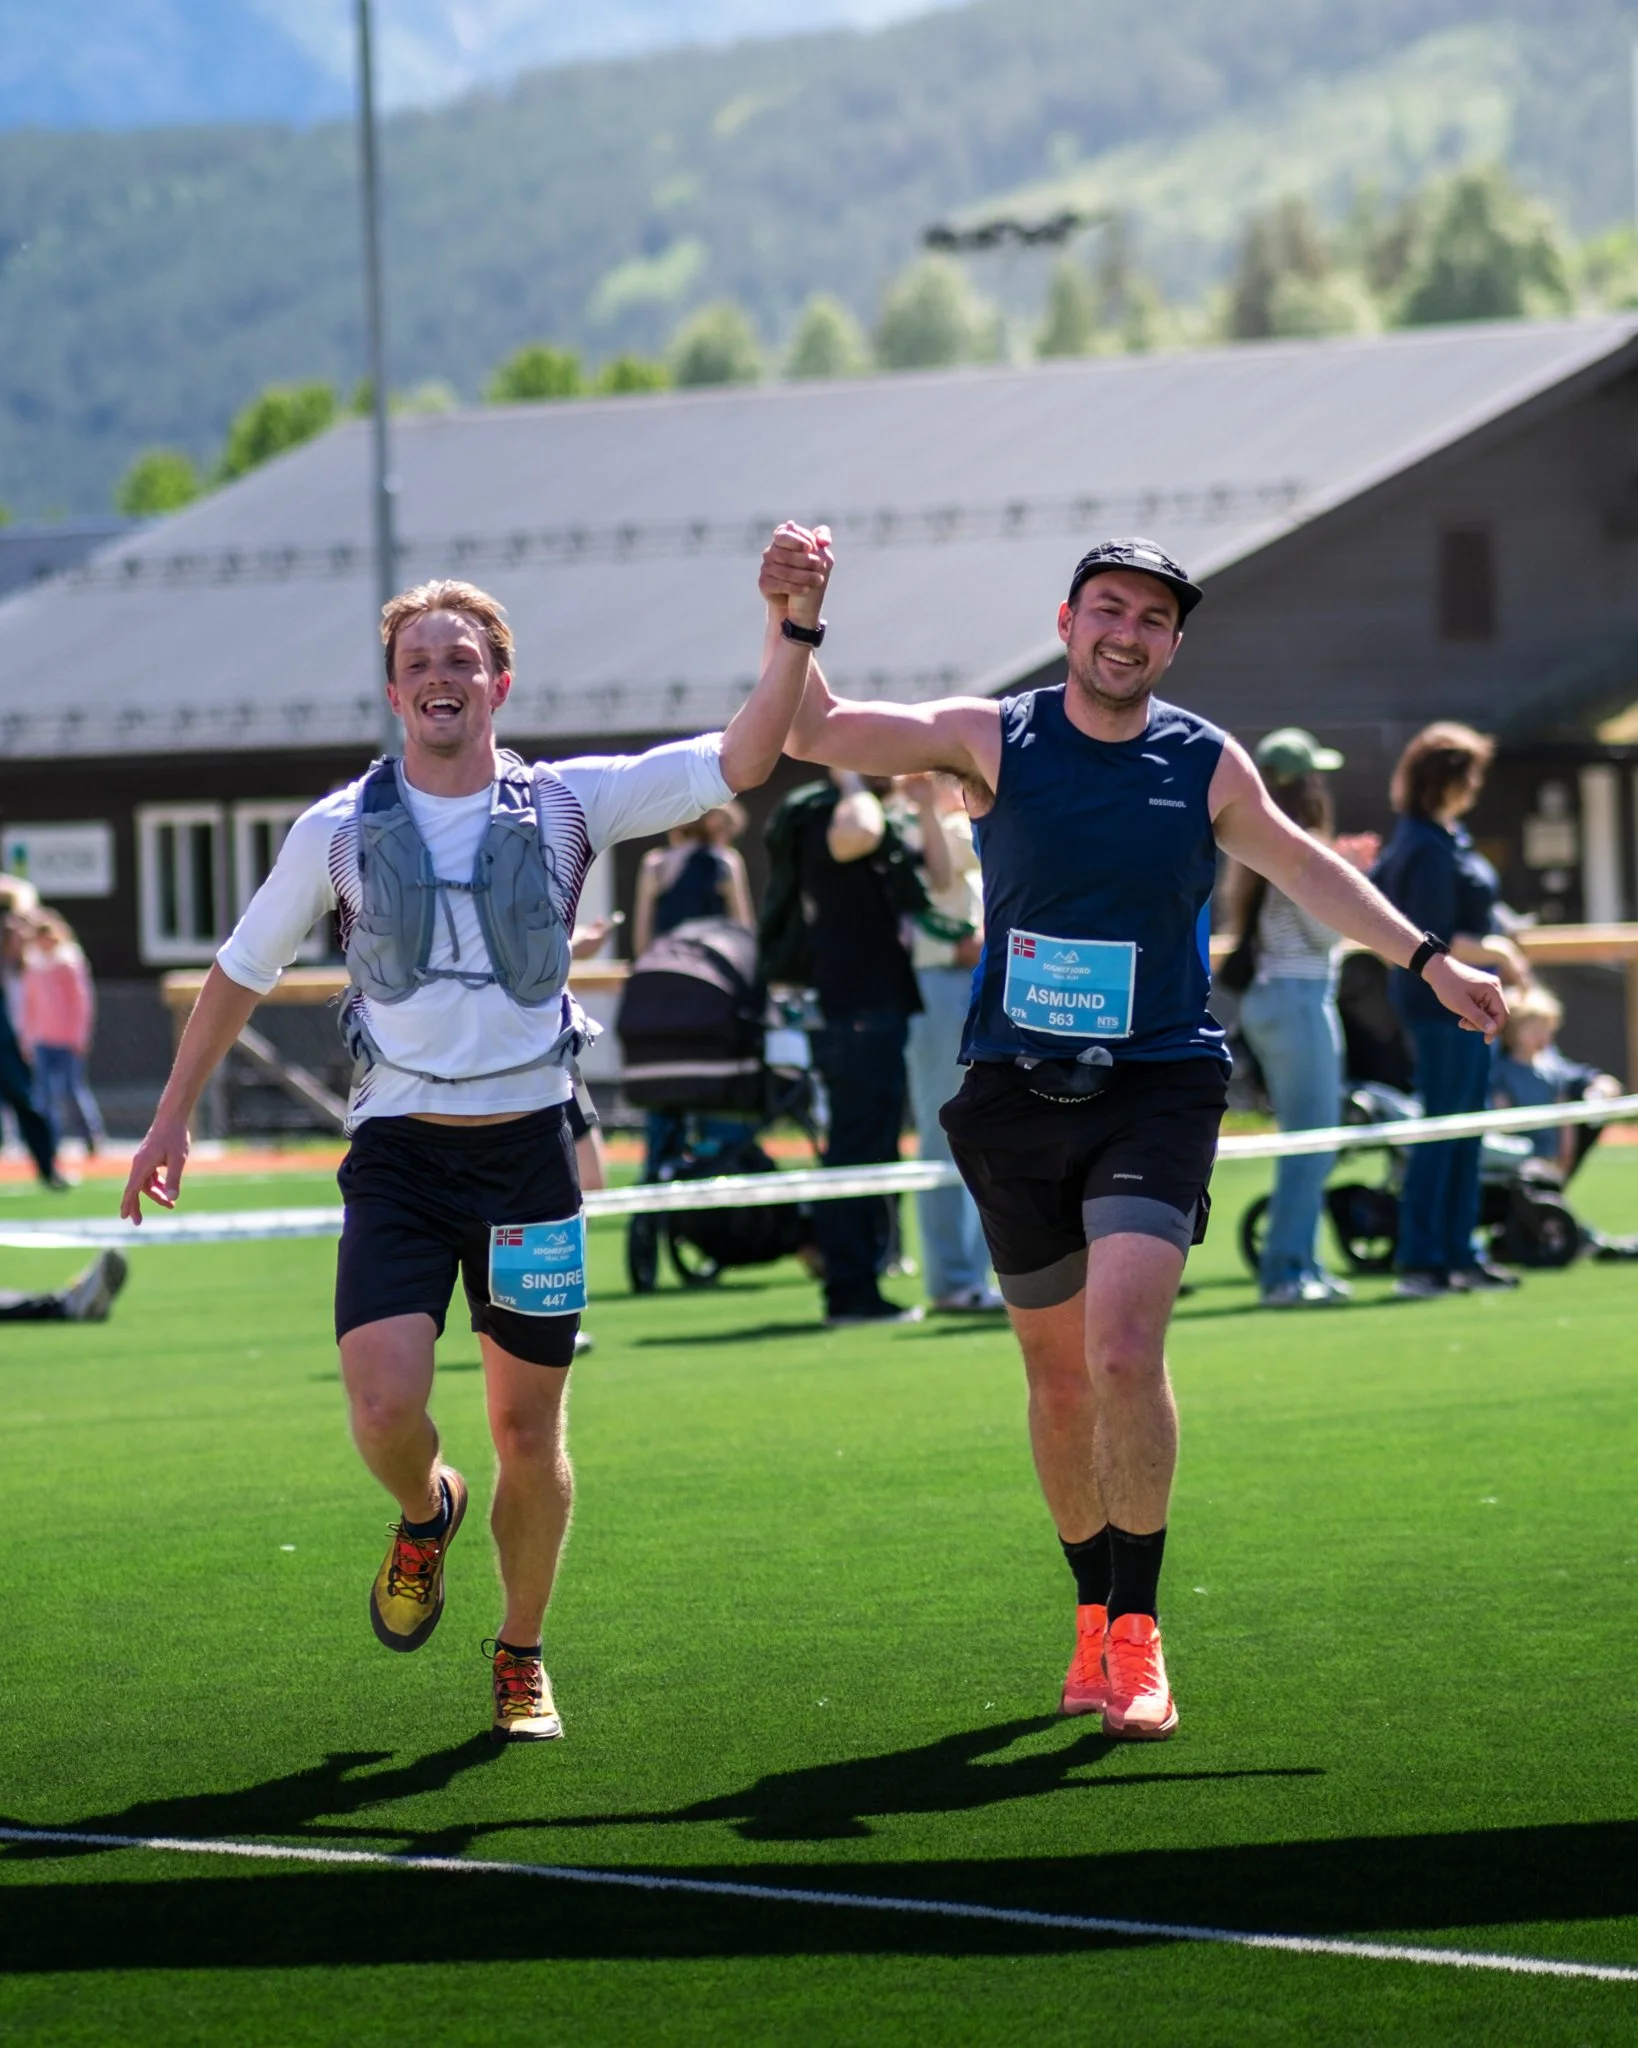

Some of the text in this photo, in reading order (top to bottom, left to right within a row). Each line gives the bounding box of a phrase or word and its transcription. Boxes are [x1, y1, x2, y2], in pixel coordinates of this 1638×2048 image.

[1026, 984, 1105, 1010] ÅSMUND
[1011, 1007, 1028, 1019] 27k
[1048, 1011, 1074, 1027] 563
[1097, 1016, 1119, 1027] NTS
[522, 1268, 582, 1288] SINDRE
[542, 1293, 568, 1307] 447
